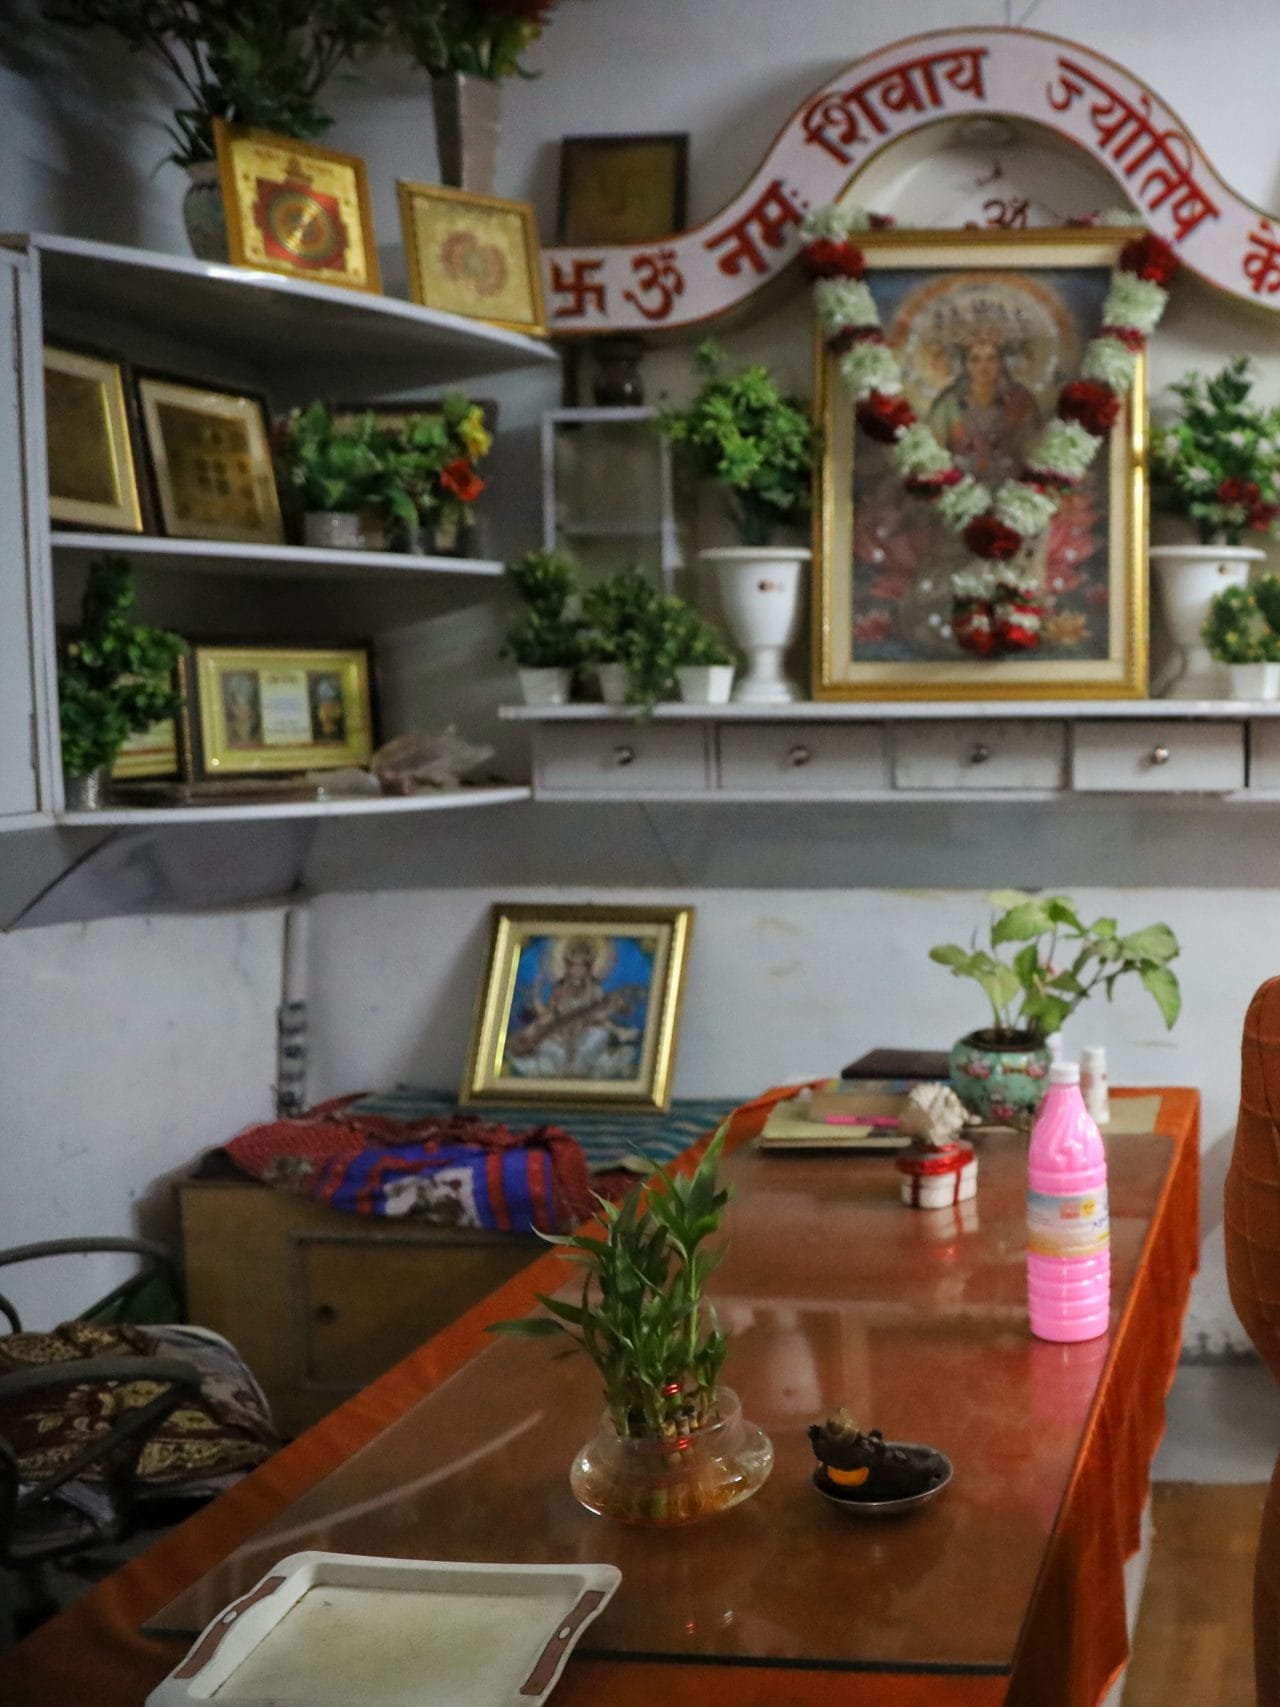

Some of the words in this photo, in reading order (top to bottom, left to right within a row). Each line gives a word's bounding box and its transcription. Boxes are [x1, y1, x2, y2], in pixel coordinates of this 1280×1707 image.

[624, 247, 684, 320] ॐ
[704, 179, 809, 277] नमः
[802, 47, 988, 166] शिवाय
[1046, 57, 1220, 243] ज्योतिष
